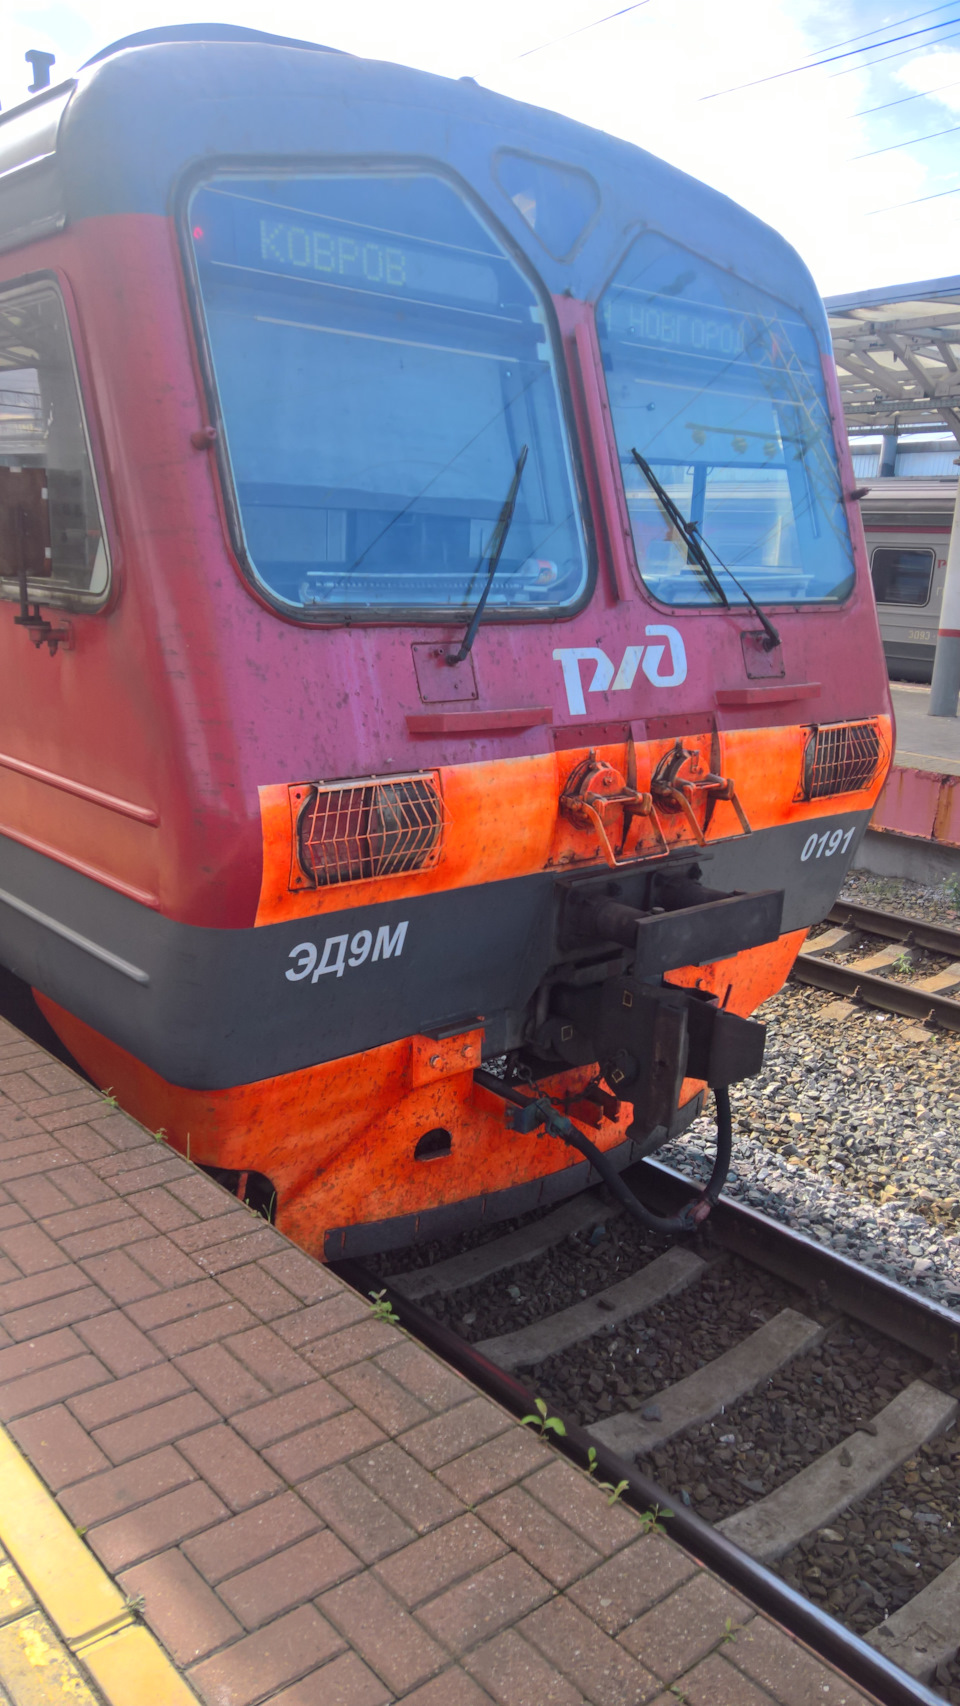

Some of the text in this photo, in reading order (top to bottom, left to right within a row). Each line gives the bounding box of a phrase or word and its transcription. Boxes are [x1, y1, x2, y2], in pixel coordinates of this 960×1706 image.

[260, 220, 406, 286] КОВРОВ
[800, 826, 856, 862] 0191
[285, 920, 409, 984] ЭД9М
